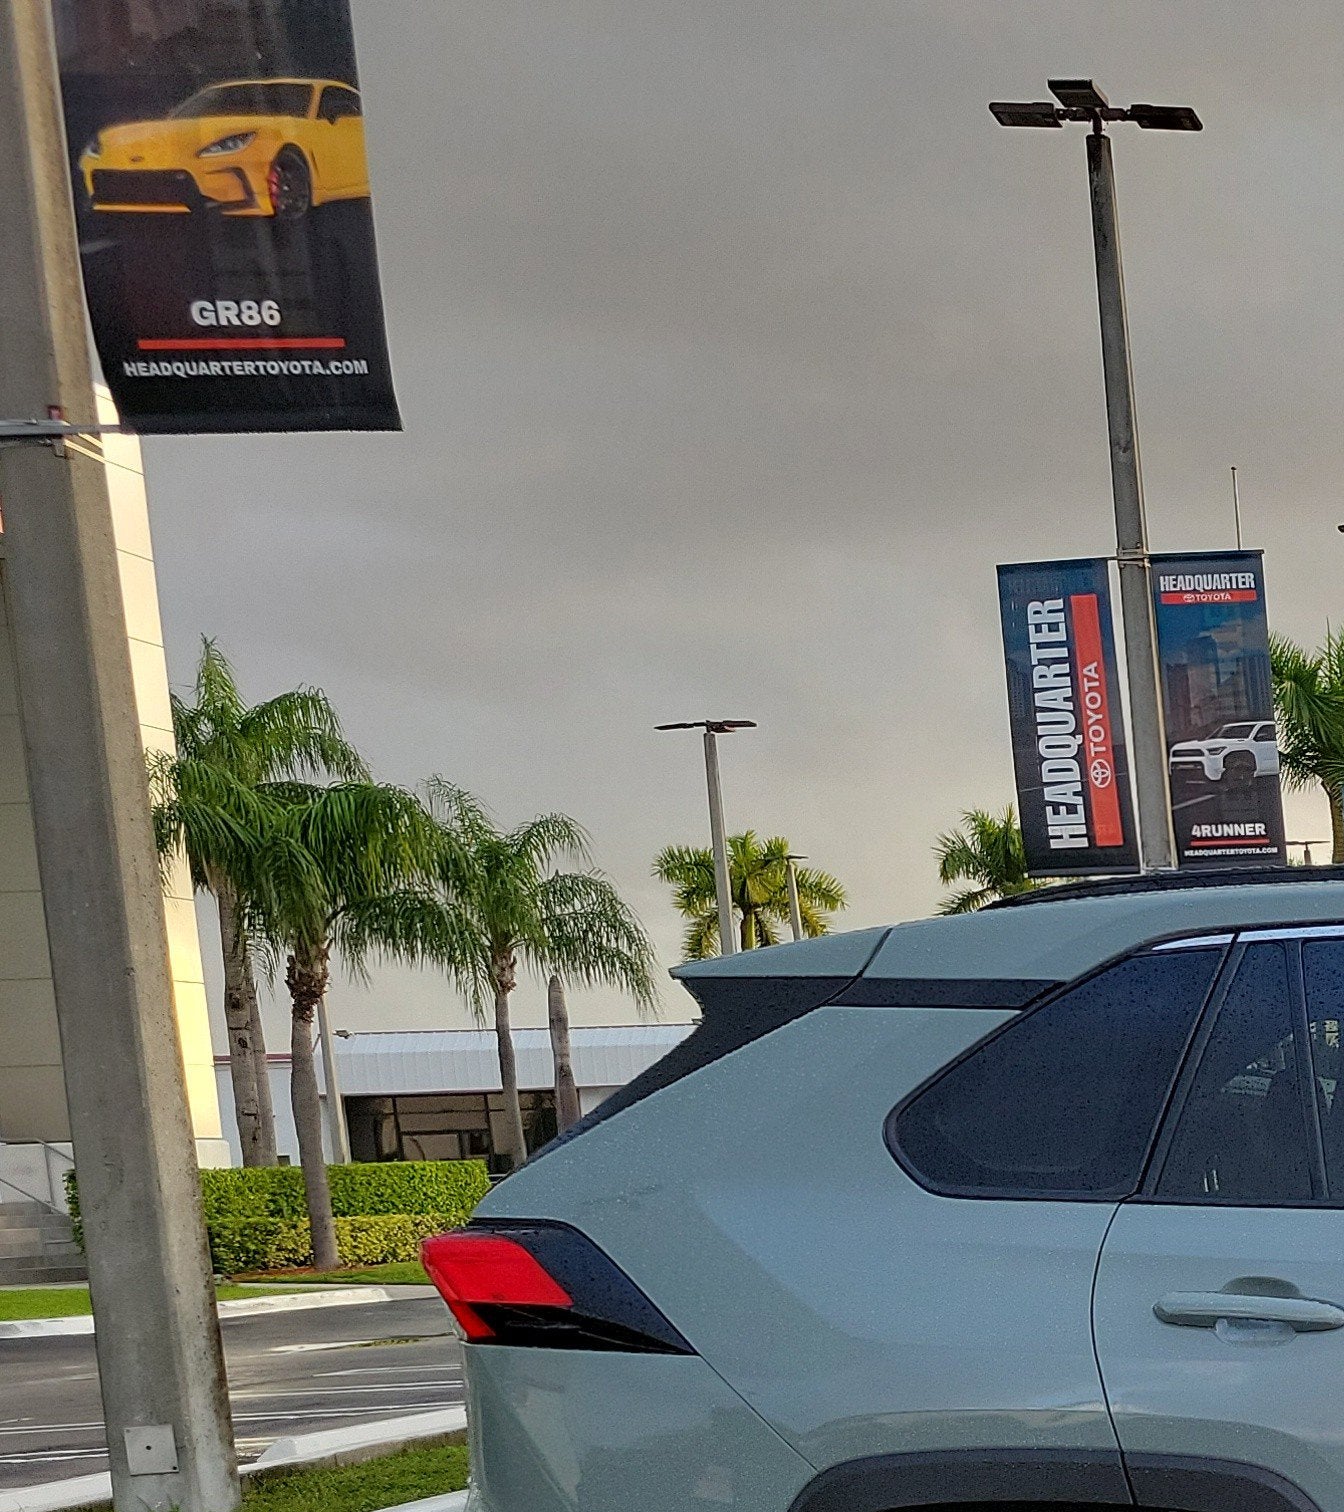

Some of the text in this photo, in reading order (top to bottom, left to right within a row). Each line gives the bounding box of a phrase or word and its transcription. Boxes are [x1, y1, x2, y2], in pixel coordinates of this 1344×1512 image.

[190, 299, 282, 327] GR86
[122, 359, 369, 379] HEADQUARTERTOYOTA.COM
[1160, 572, 1255, 592] HEADQUARTER
[1196, 592, 1231, 602] TOYOTA
[1082, 661, 1107, 757] TOYOTA
[1027, 598, 1090, 849] HEADQUARTER
[1191, 823, 1267, 837] 4RUNNER
